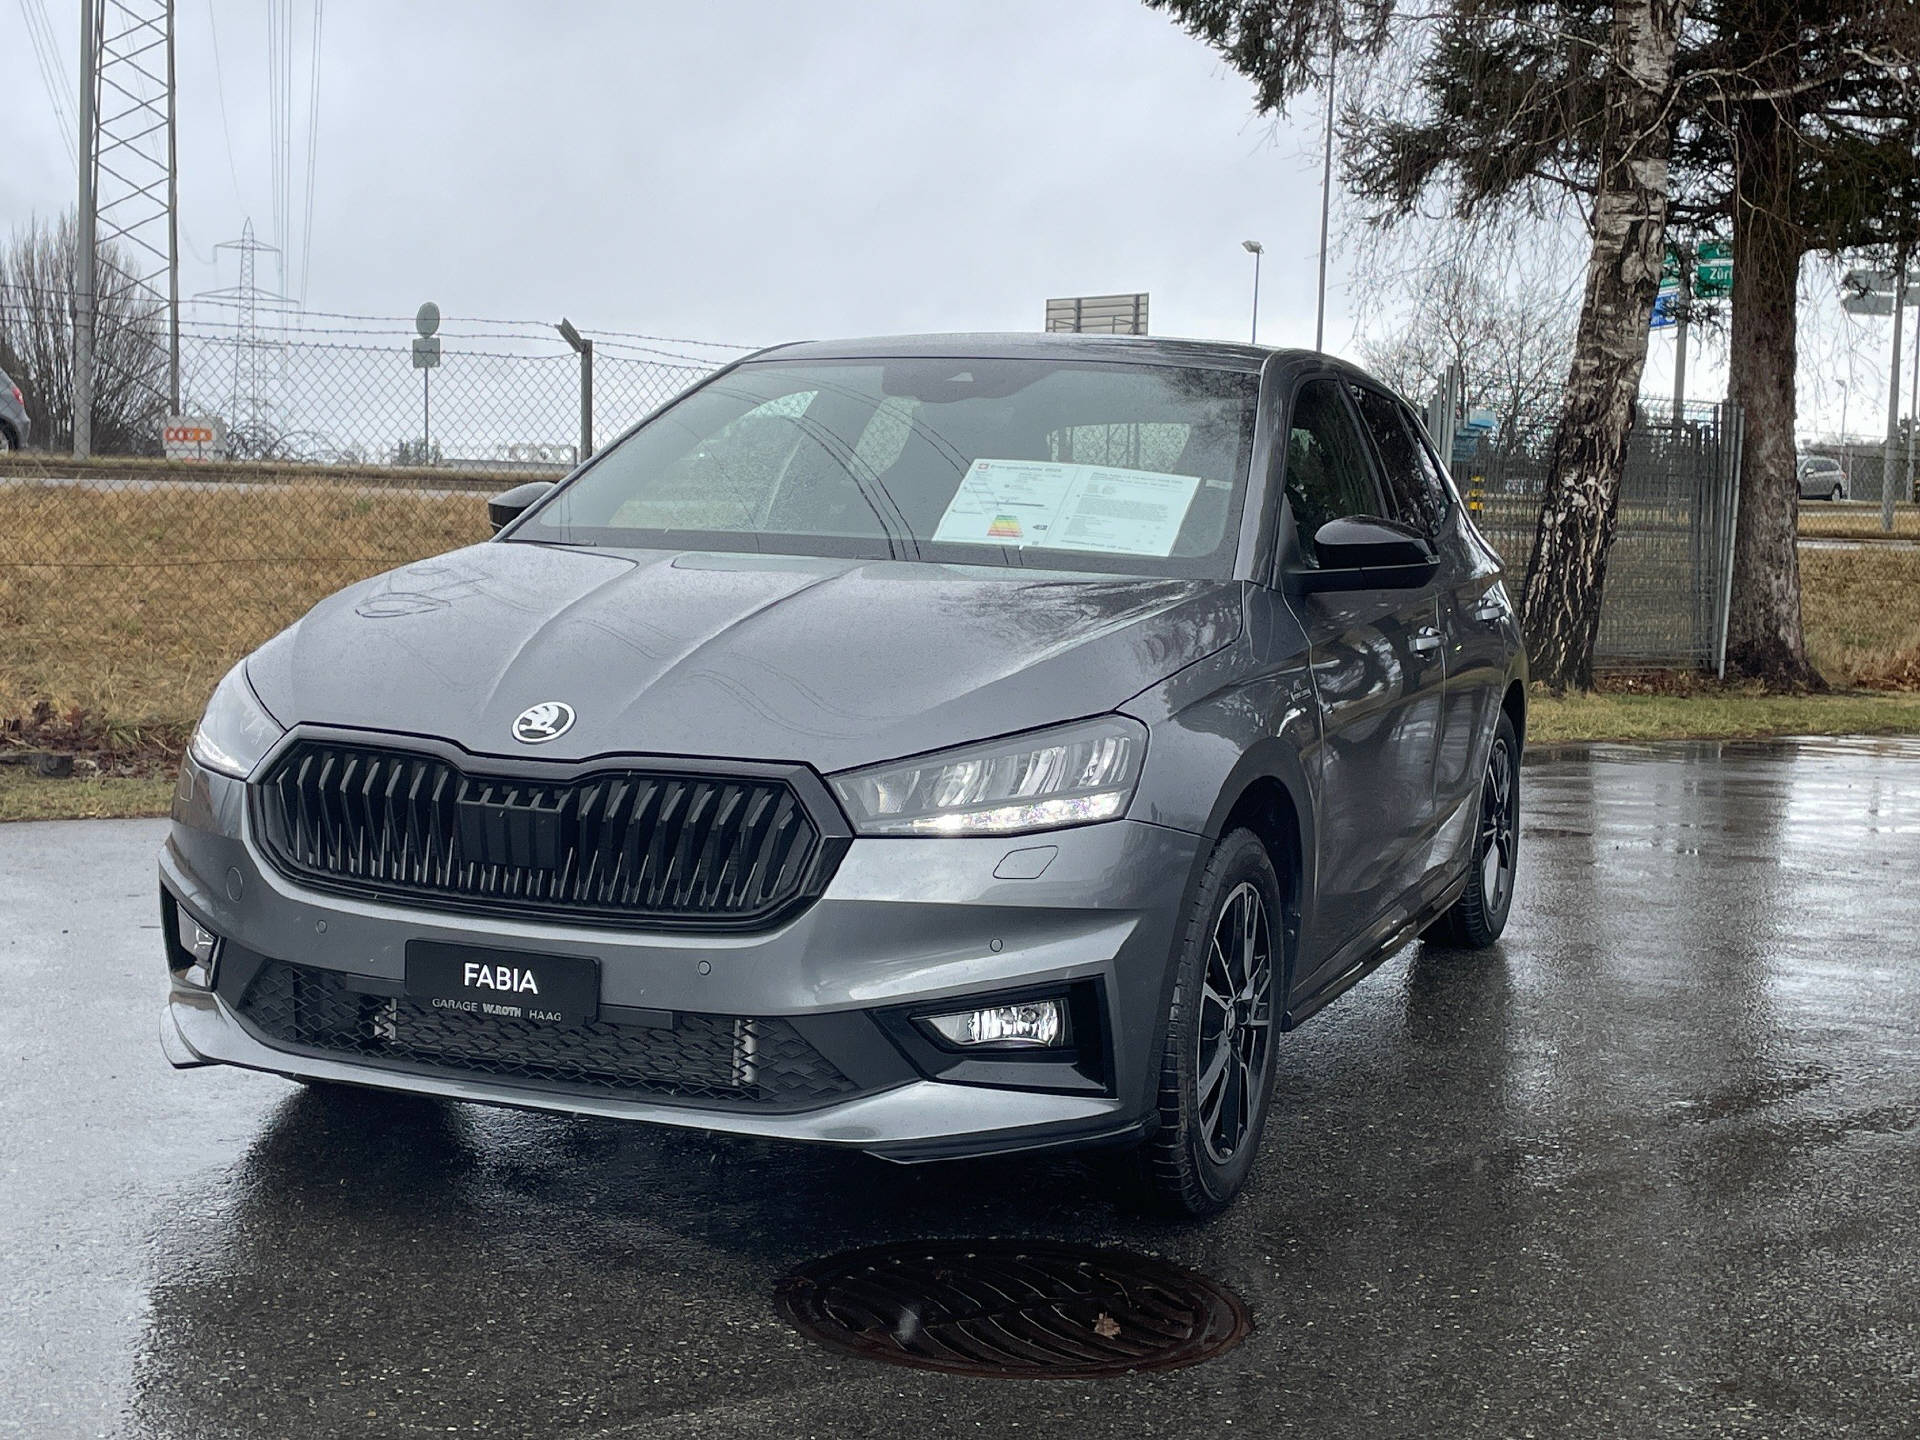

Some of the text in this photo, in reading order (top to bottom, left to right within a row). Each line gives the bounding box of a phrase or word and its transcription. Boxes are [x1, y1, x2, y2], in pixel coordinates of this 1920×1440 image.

[463, 962, 539, 994] FABIA
[432, 998, 478, 1012] GARAGE
[529, 1010, 562, 1022] HAAG
